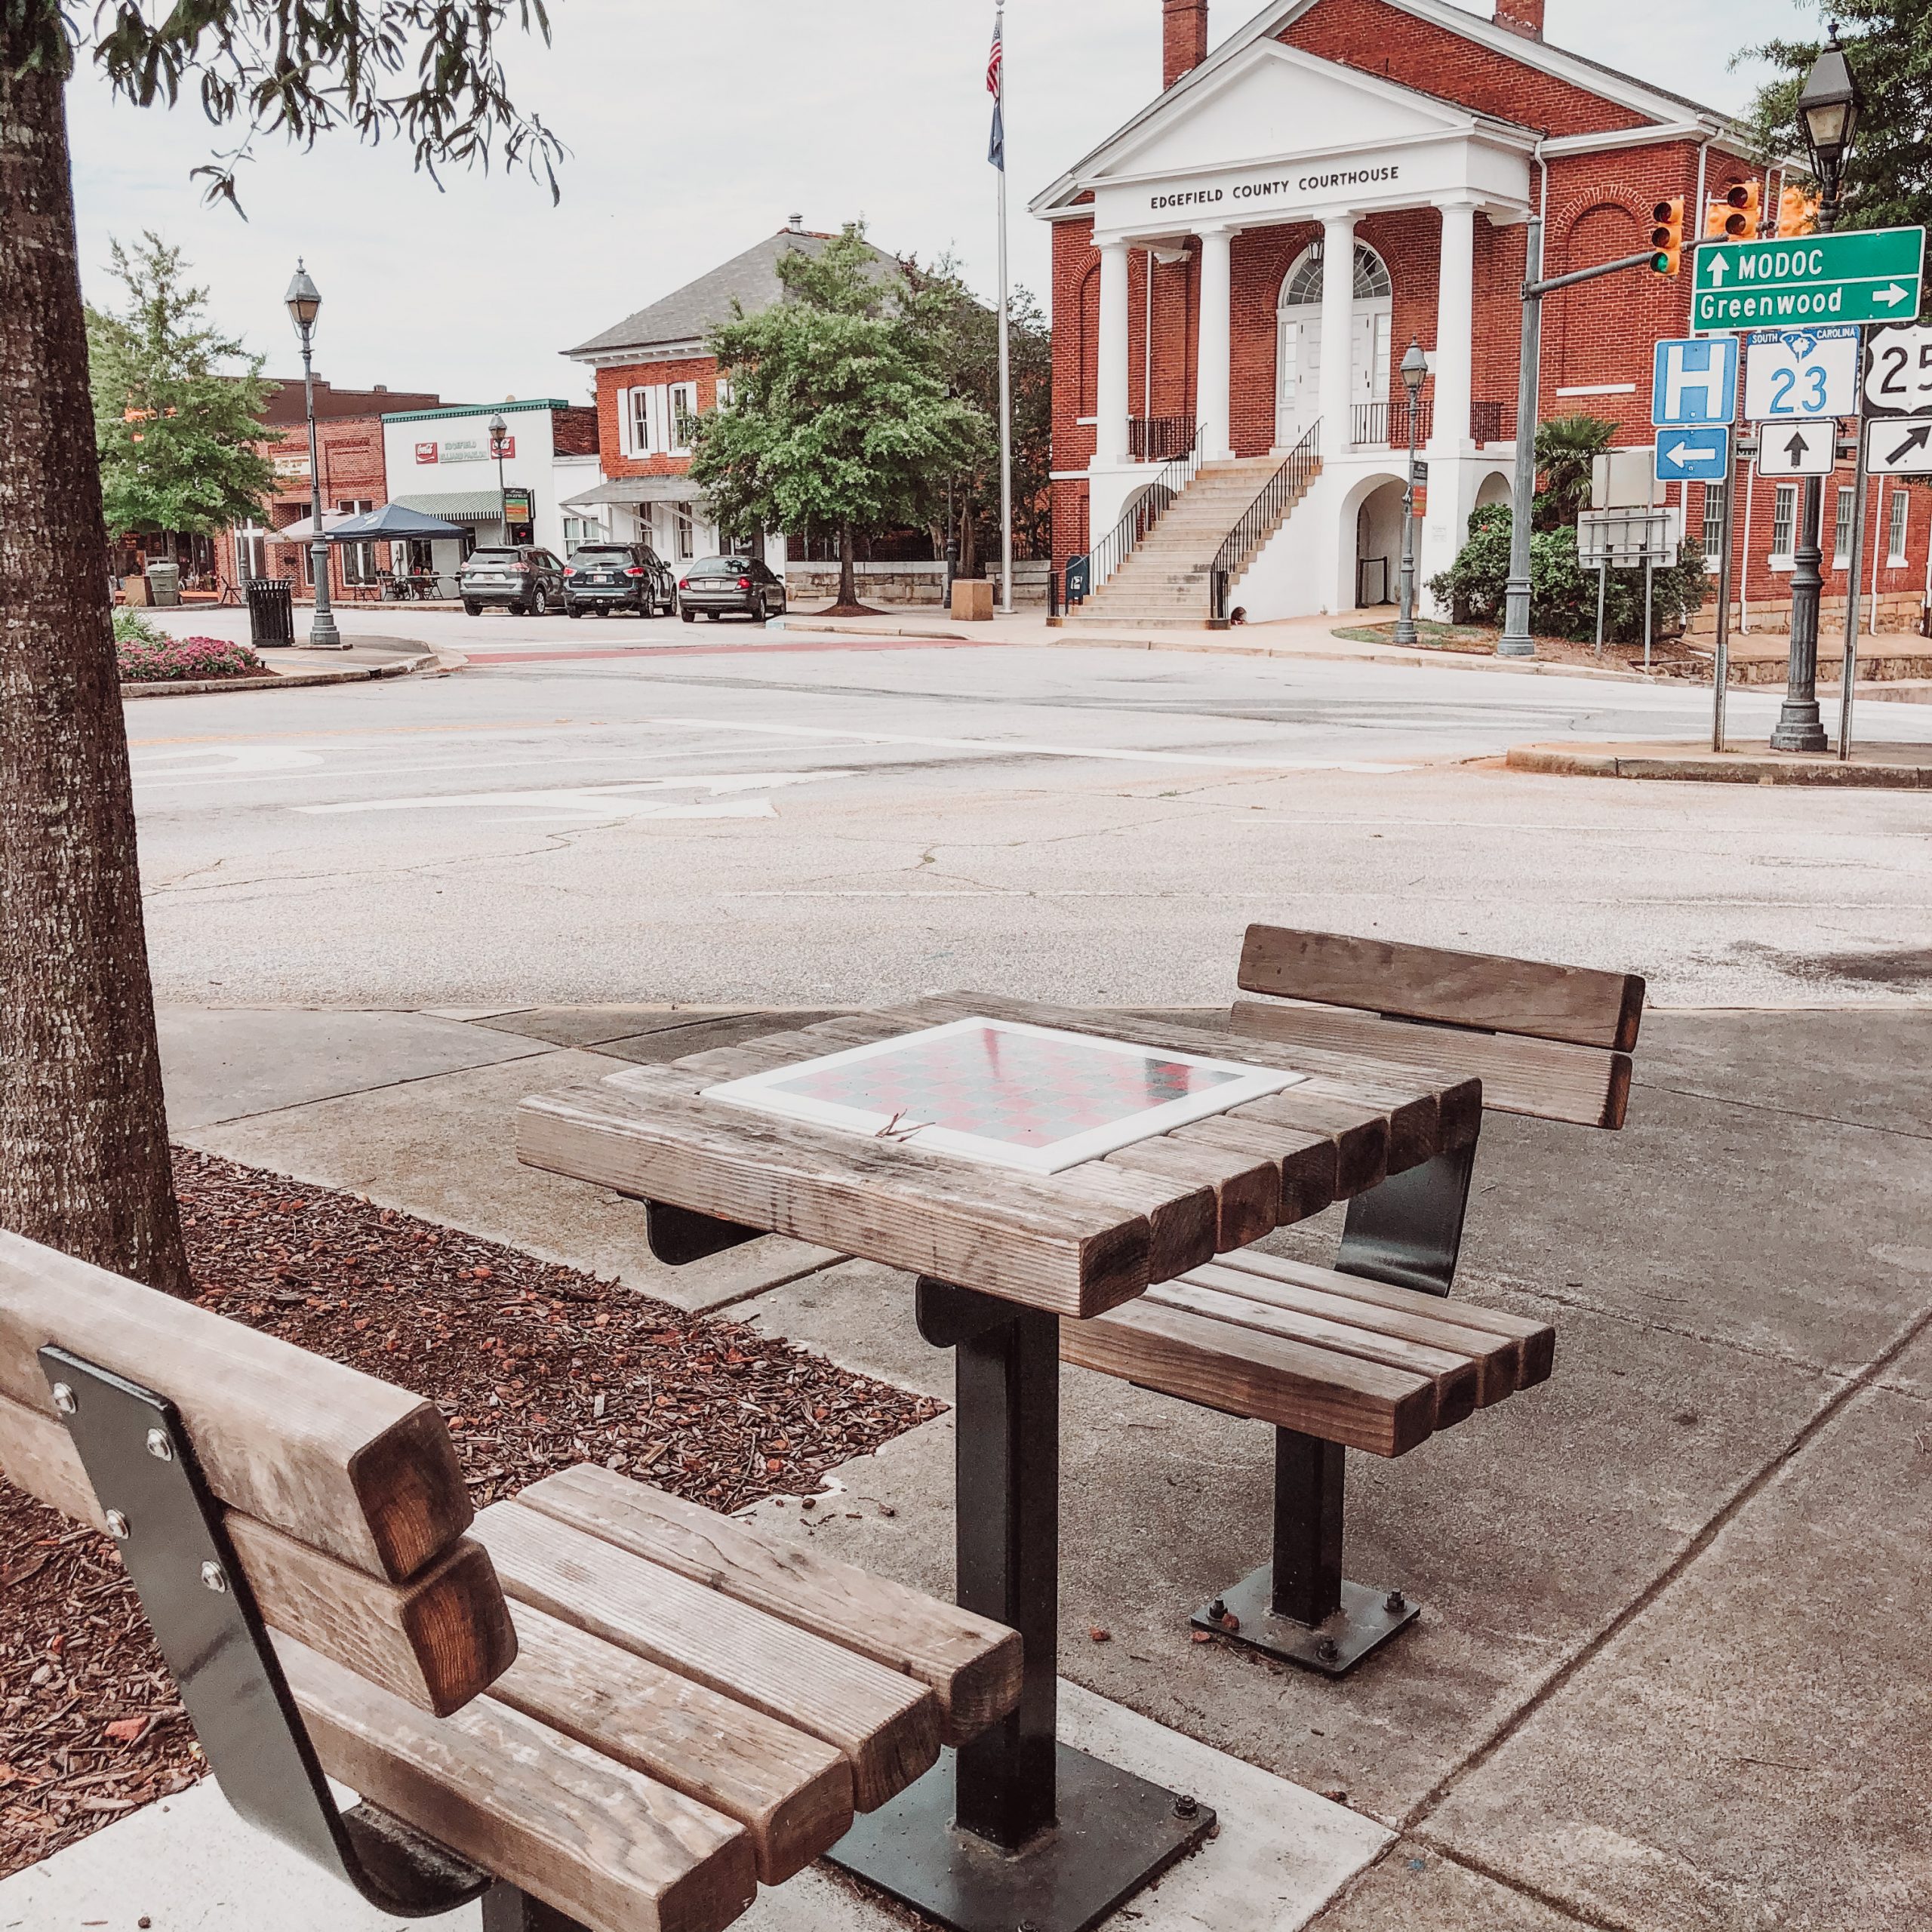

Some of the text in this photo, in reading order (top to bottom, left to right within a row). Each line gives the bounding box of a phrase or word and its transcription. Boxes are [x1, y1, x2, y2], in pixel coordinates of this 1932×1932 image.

[1151, 167, 1399, 209] EDGEFIELD COUNTY COURTHOUSE
[1739, 249, 1823, 280] MODOC
[1700, 287, 1842, 319] Greenwood
[1752, 328, 1855, 343] SOUTH CAROLINA
[1665, 343, 1726, 420] H
[1769, 366, 1827, 414] 23
